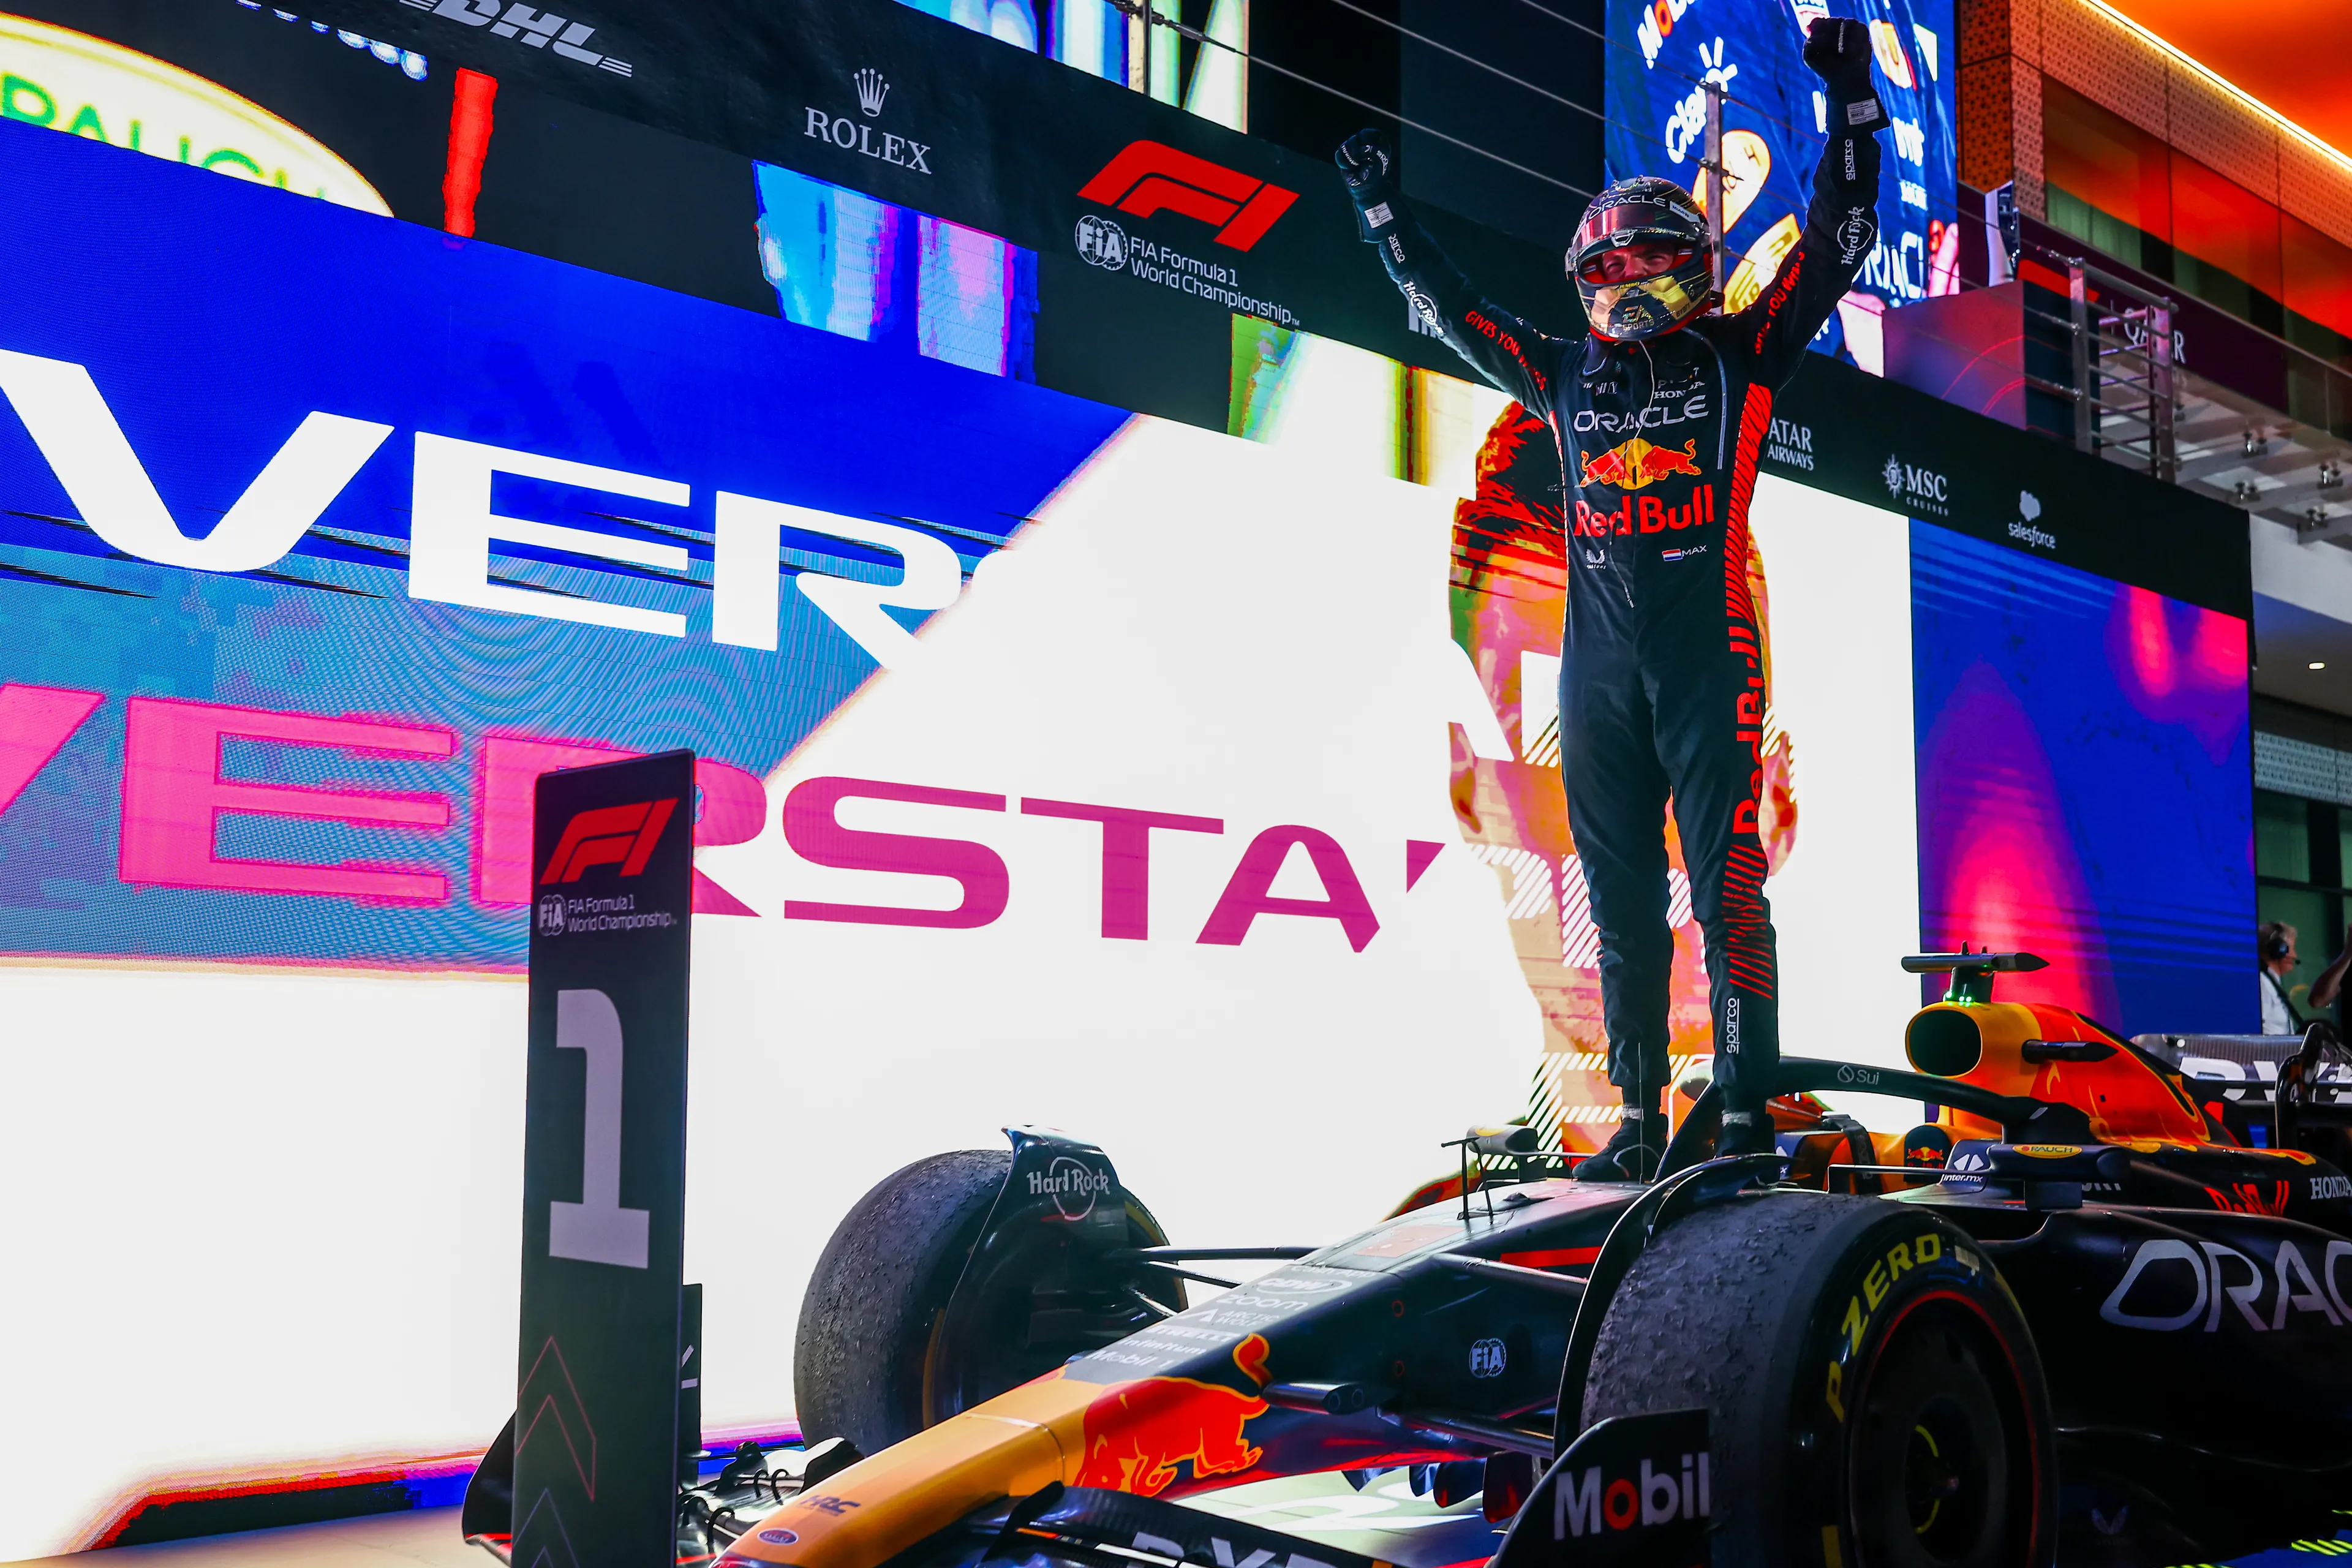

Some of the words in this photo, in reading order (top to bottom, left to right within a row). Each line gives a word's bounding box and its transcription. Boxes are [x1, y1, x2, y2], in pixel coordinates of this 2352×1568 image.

[432, 0, 604, 66] DHL
[804, 107, 932, 175] ROLEX
[1845, 138, 1855, 181] sparco
[1588, 195, 1665, 220] ORACLE
[1131, 236, 1157, 261] FIA
[1161, 247, 1226, 282] Formula
[1228, 269, 1238, 287] 1
[1389, 233, 1405, 263] parco
[1841, 234, 1858, 265] Hard
[1131, 258, 1179, 288] World
[1183, 276, 1291, 324] Championship
[1403, 281, 1428, 309] Hard
[1466, 311, 1498, 338] GIVES
[1497, 331, 1521, 355] YOU
[1623, 319, 1654, 331] SPORTS
[1574, 395, 1709, 432] ORACLE
[1768, 417, 1812, 453] ATAR
[1768, 444, 1814, 470] AIRWAYS
[1905, 464, 1947, 502] MSC
[0, 348, 1014, 669] VER
[1573, 495, 1632, 537] Red
[1638, 484, 1714, 533] Bull
[2008, 522, 2056, 549] salesforce
[1681, 545, 1707, 557] MAX
[0, 683, 1446, 953] ERSTA
[568, 899, 583, 912] FIA
[586, 895, 627, 912] Formula
[628, 894, 635, 910] 1
[568, 916, 598, 932] World
[1727, 998, 1740, 1054] sparco
[1856, 1069, 1879, 1085] Sui
[549, 989, 649, 1269] 1
[2030, 1144, 2073, 1153] RAUCH
[1027, 1169, 1068, 1195] Hard
[1072, 1169, 1110, 1196] Rock
[2310, 1177, 2352, 1200] HONDA
[1216, 1294, 1308, 1311] zoom
[1218, 1310, 1280, 1321] ARCTIC
[1215, 1316, 1264, 1327] WOLF
[1826, 1362, 1844, 1423] P
[1841, 1233, 1940, 1356] ZERO
[1087, 1350, 1159, 1366] Mobil
[1554, 1452, 1711, 1541] Mobil
